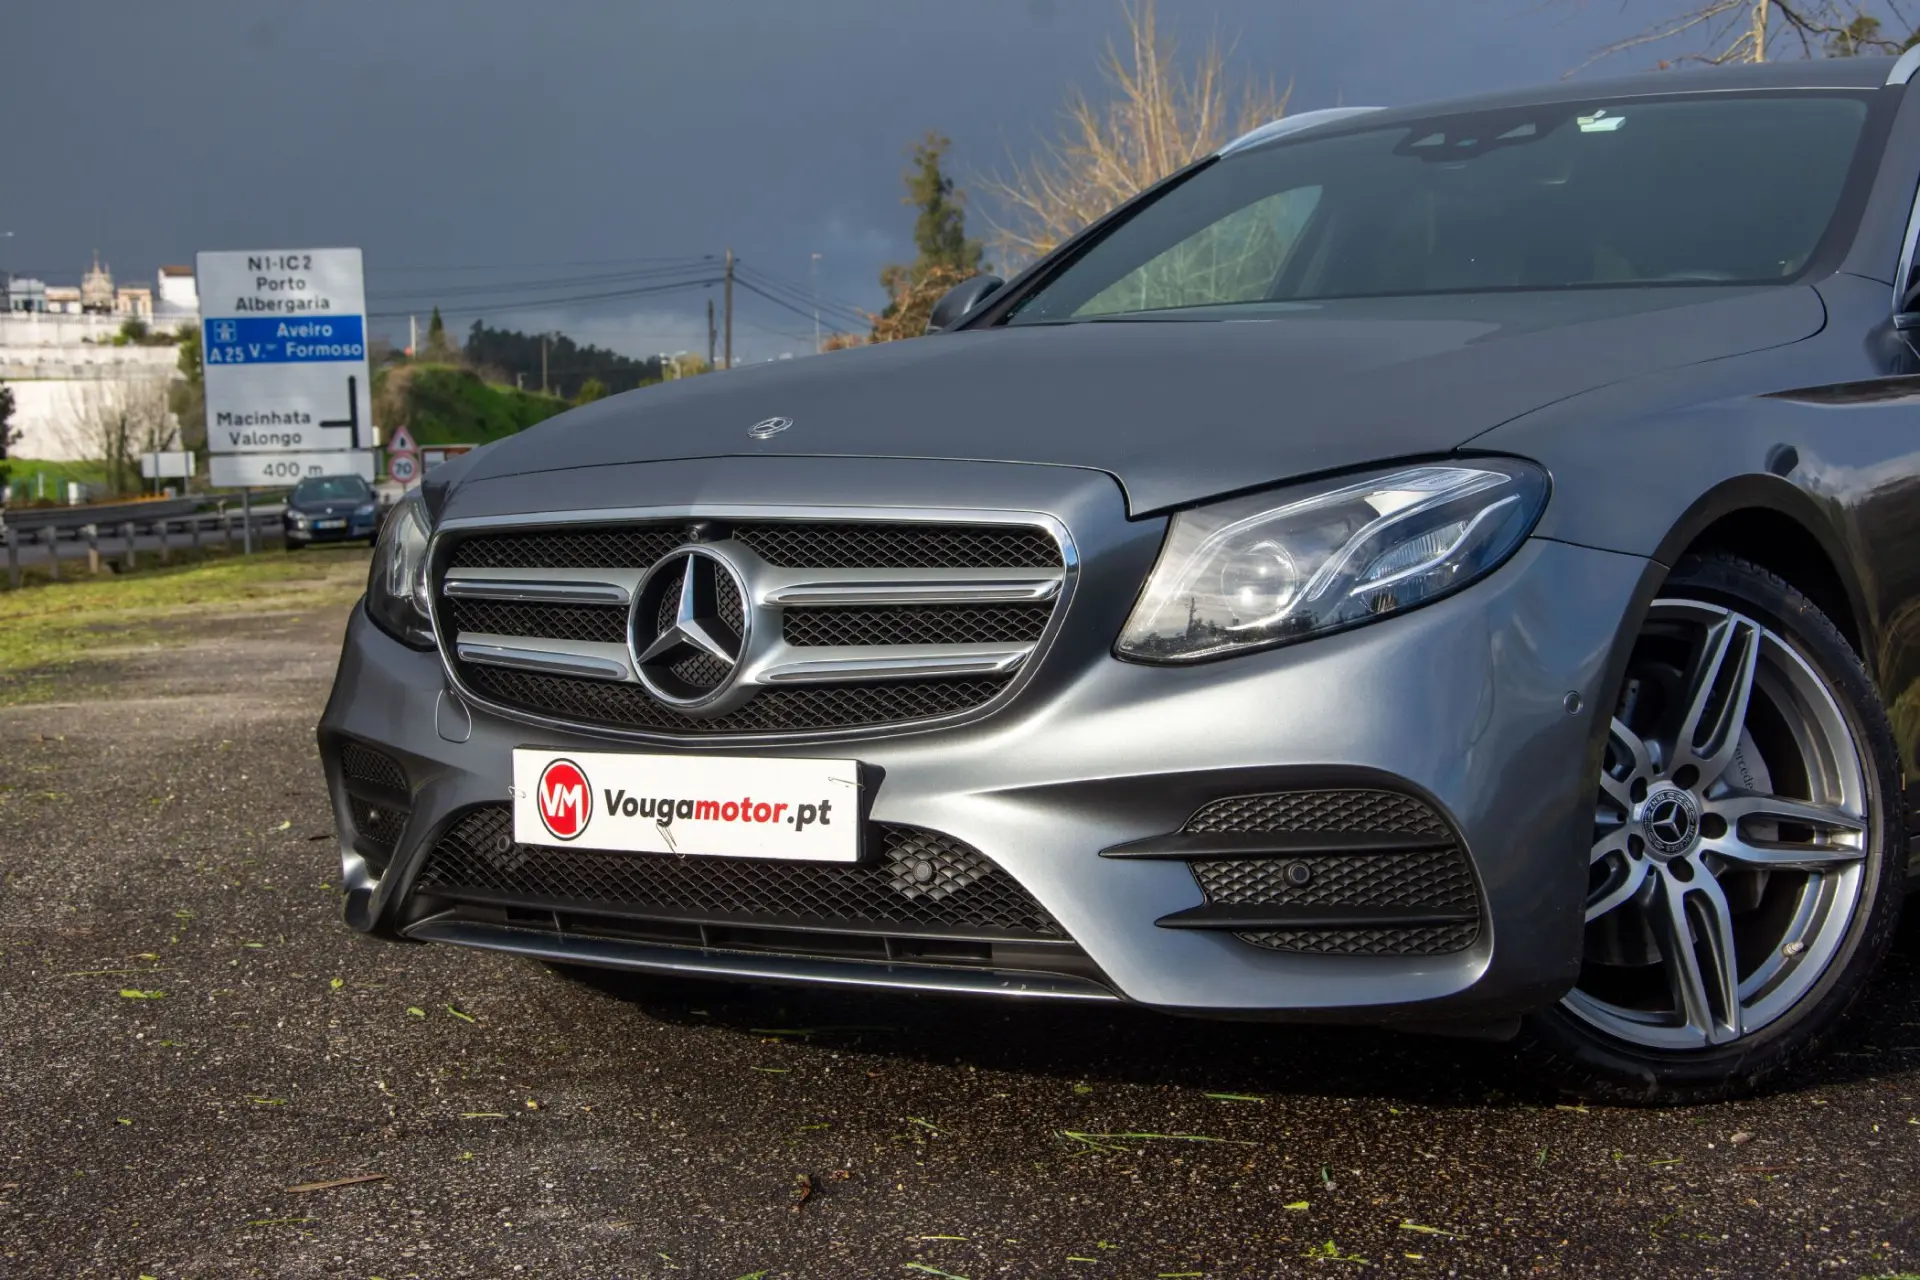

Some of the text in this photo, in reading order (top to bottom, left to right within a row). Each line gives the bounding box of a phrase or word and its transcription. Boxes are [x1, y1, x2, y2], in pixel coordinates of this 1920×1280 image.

[256, 276, 306, 292] Porto
[235, 296, 331, 313] Albergaria
[277, 322, 333, 338] Aveiro
[286, 343, 363, 358] Formoso
[216, 411, 312, 427] Macinhata
[229, 431, 302, 447] Valongo
[262, 463, 323, 478] 400 m
[395, 462, 412, 475] 70
[541, 783, 583, 833] VM
[604, 788, 832, 832] Vougamotor.pt
